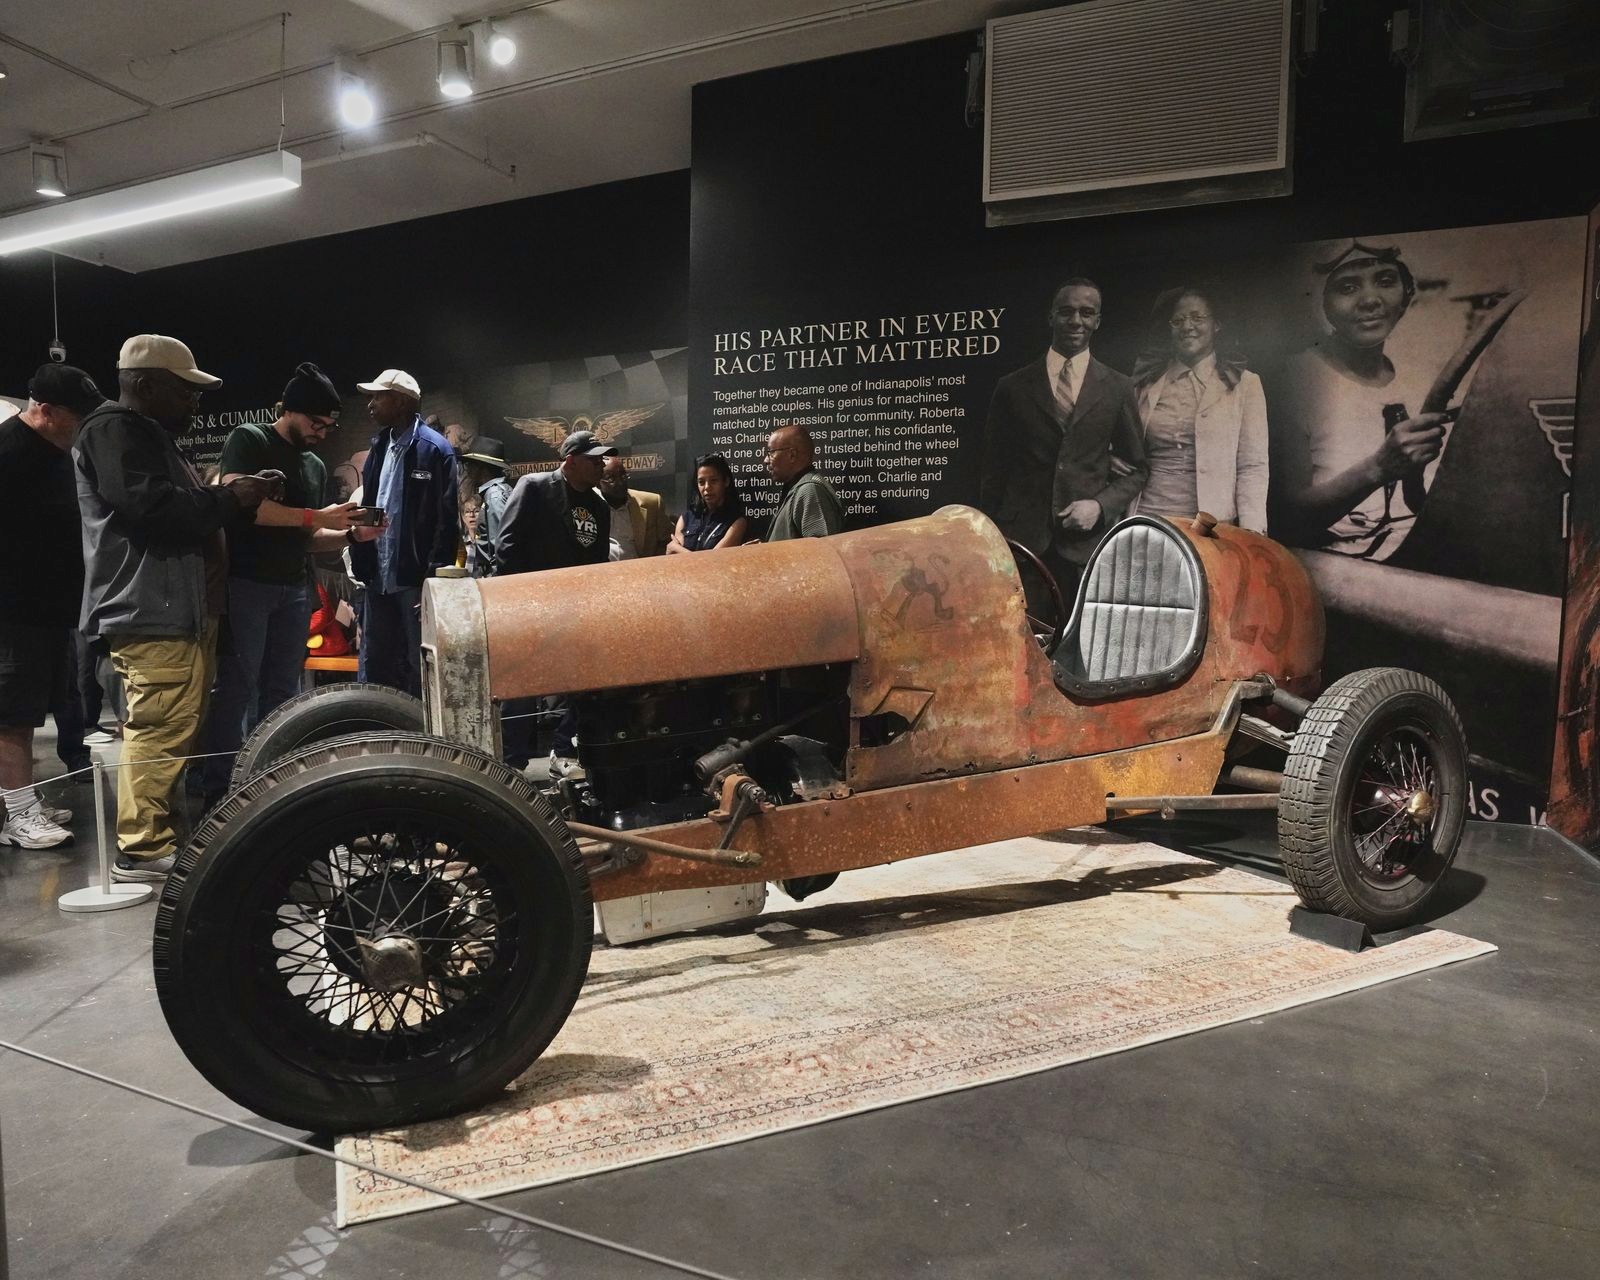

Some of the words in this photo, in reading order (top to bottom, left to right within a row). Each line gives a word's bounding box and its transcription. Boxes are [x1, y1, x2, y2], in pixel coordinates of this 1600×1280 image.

[714, 331, 752, 352] HIS
[760, 320, 868, 348] PARTNER
[879, 316, 906, 338] IN
[915, 308, 1006, 335] EVERY
[713, 351, 776, 376] RACE
[784, 346, 848, 370] THAT
[855, 334, 1000, 364] MATTERED
[713, 389, 757, 402] Together
[759, 388, 781, 399] they
[783, 385, 825, 396] became
[828, 384, 848, 393] one
[851, 380, 862, 391] of
[865, 376, 935, 391] Indianapolis'
[937, 374, 966, 386] most
[713, 403, 769, 416] remarkable
[771, 400, 814, 413] couples.
[817, 398, 835, 409] His
[838, 396, 874, 410] genius
[877, 394, 892, 405] for
[894, 392, 949, 404] machines
[207, 413, 217, 428] &
[713, 418, 756, 430] matched
[758, 417, 771, 430] by
[773, 416, 790, 427] her
[793, 414, 833, 426] passion
[836, 412, 851, 423] for
[853, 409, 916, 422] community.
[919, 406, 965, 419] Roberta
[713, 435, 733, 445] was
[830, 427, 871, 441] partner,
[874, 425, 891, 436] his
[894, 423, 956, 436] confidante,
[734, 449, 753, 458] one
[755, 446, 766, 457] of
[824, 441, 861, 454] trusted
[864, 440, 901, 452] behind
[904, 439, 922, 450] the
[925, 438, 959, 449] wheel
[742, 463, 764, 473] race
[824, 458, 847, 471] they
[850, 457, 873, 468] built
[876, 456, 922, 470] together
[925, 455, 948, 465] was
[750, 476, 772, 487] than
[849, 474, 874, 484] won.
[877, 471, 917, 483] Charlie
[920, 470, 942, 482] and
[864, 489, 877, 499] as
[880, 487, 930, 500] enduring
